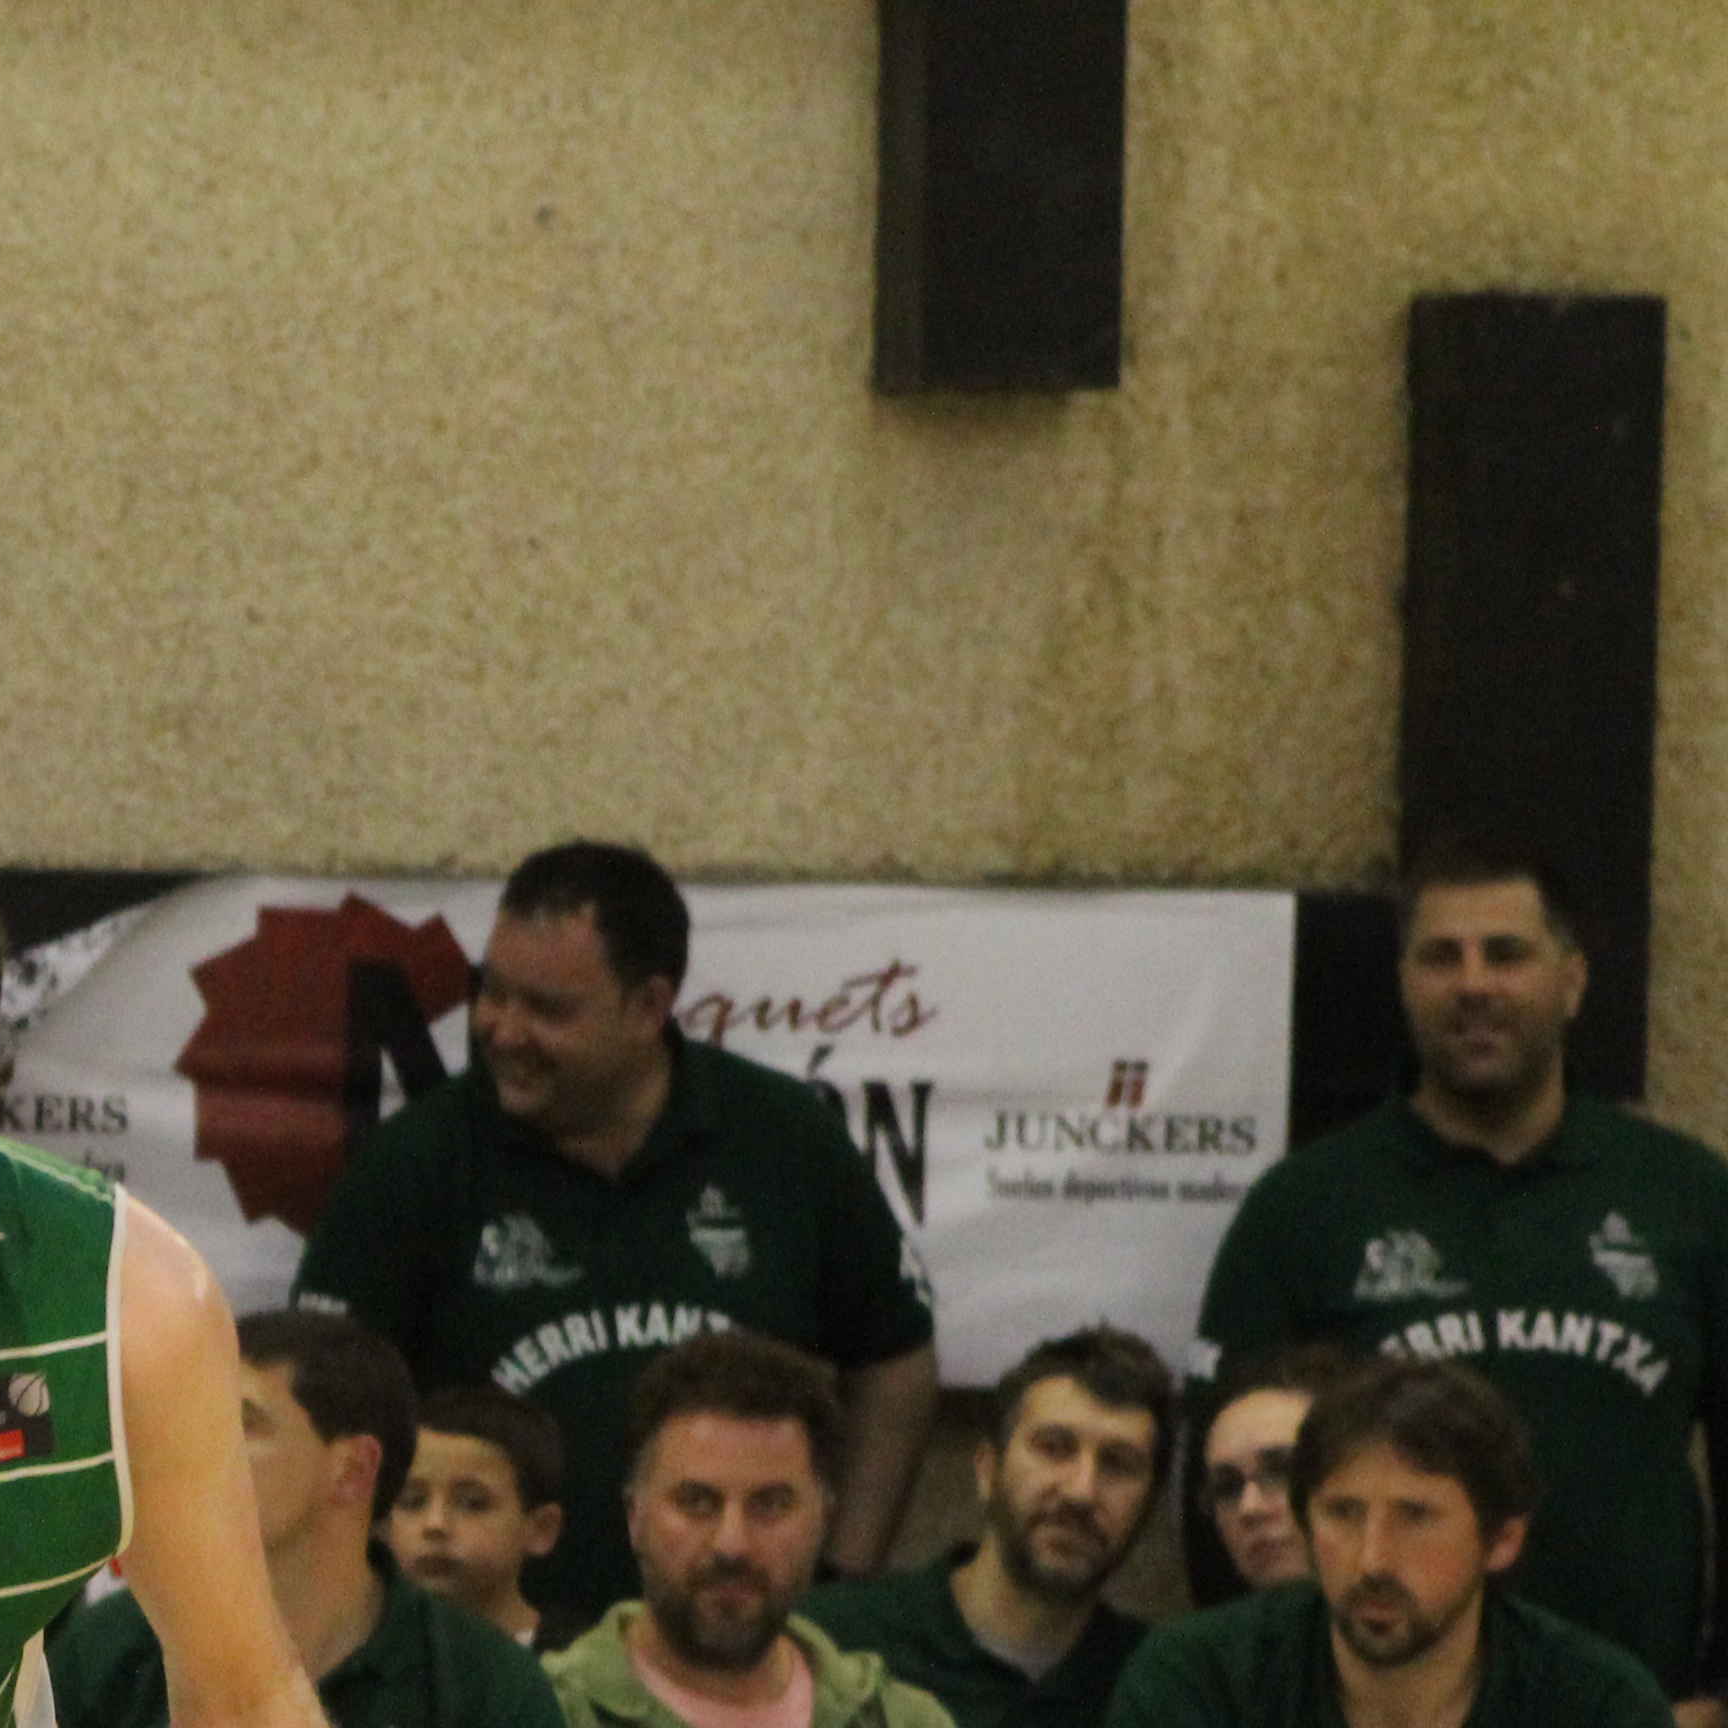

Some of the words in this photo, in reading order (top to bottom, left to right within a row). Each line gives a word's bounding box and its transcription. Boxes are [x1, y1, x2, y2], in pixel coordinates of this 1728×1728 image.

[672, 958, 937, 1050] quets
[982, 1110, 1258, 1154] JUNCKERS
[1496, 1309, 1670, 1396] KANTXA
